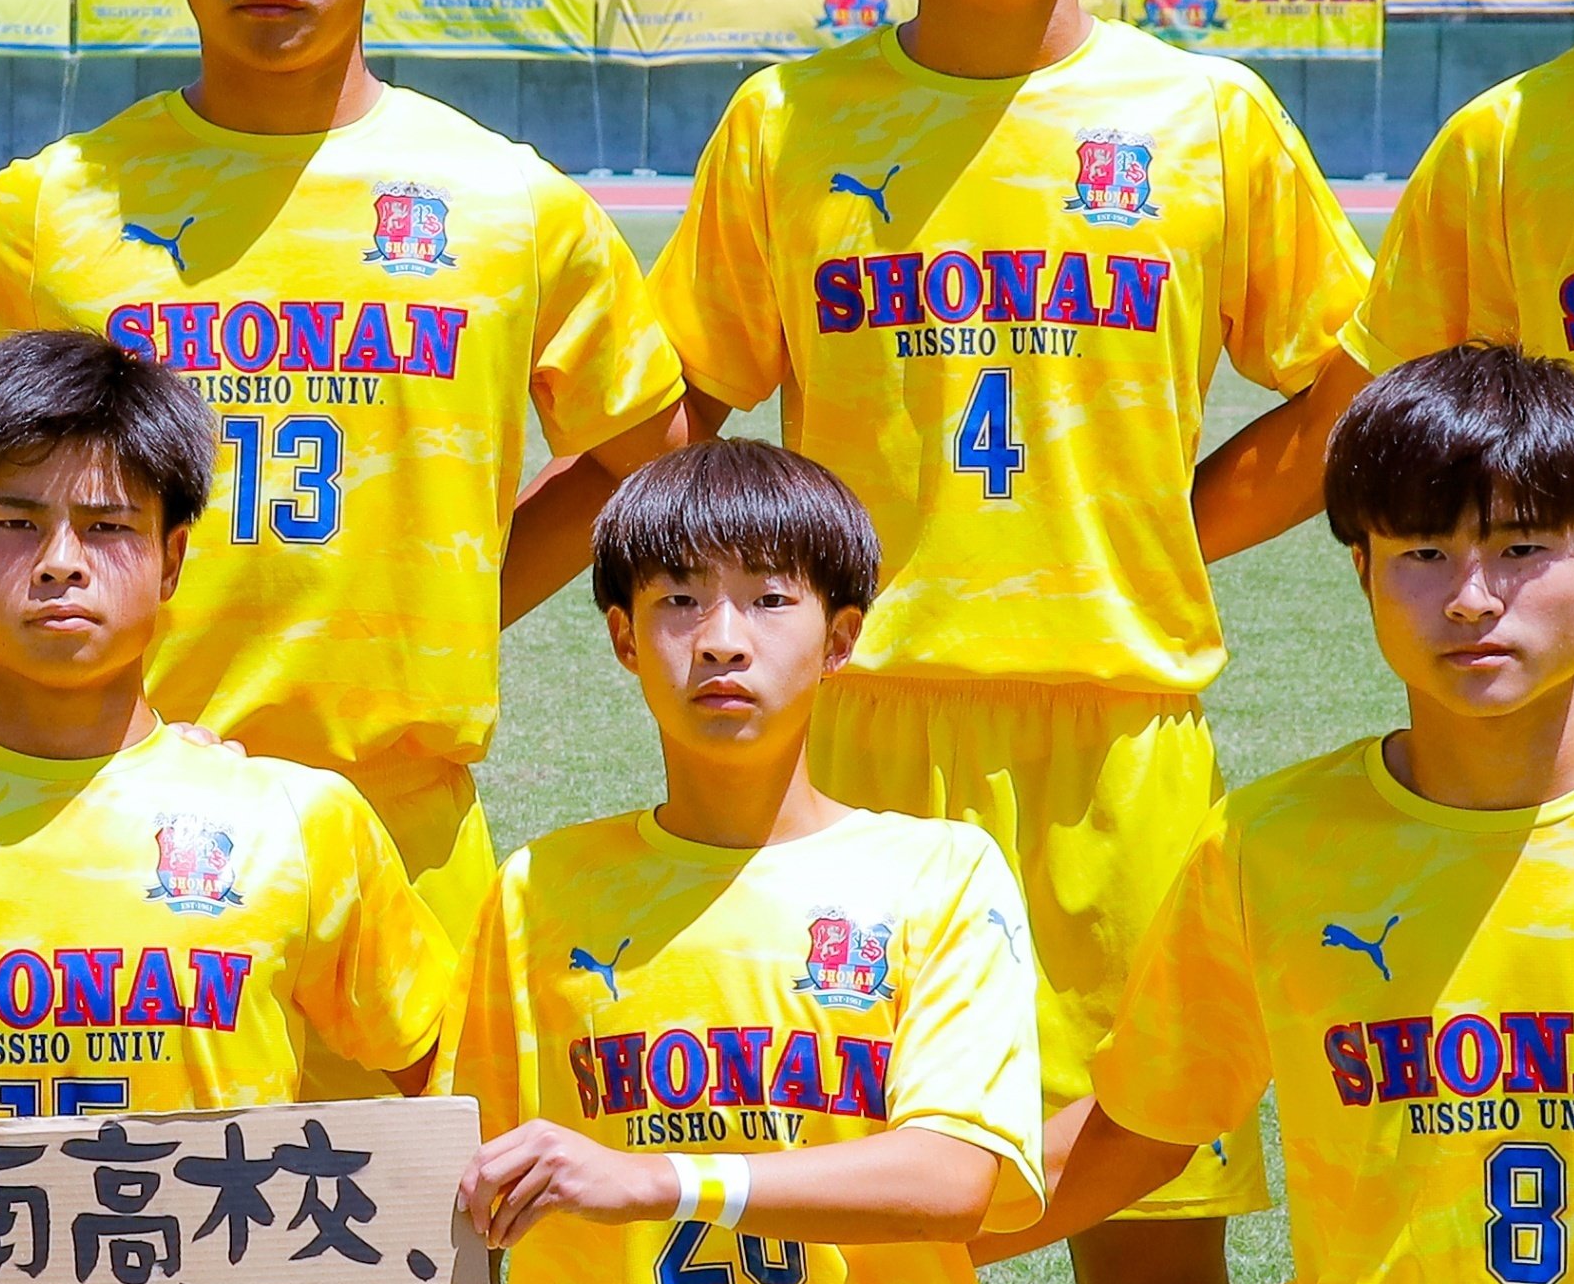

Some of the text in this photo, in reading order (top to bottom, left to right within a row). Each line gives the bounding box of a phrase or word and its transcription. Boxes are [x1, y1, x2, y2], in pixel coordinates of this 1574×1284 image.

[1087, 188, 1140, 204] SHONAN
[385, 242, 436, 255] SHONAN
[814, 250, 1170, 334] SHONAN
[106, 301, 468, 380] SHONAN
[895, 327, 1082, 358] RISSHO UNIV.
[306, 376, 384, 405] UNIV.
[954, 367, 1025, 500] 4
[221, 414, 343, 545] 13
[169, 876, 223, 893] SHONAN
[818, 970, 876, 986] SHONAN
[87, 1031, 171, 1062] UNIV.
[569, 1027, 893, 1120] SHONAN
[1409, 1098, 1521, 1134] RISSHO
